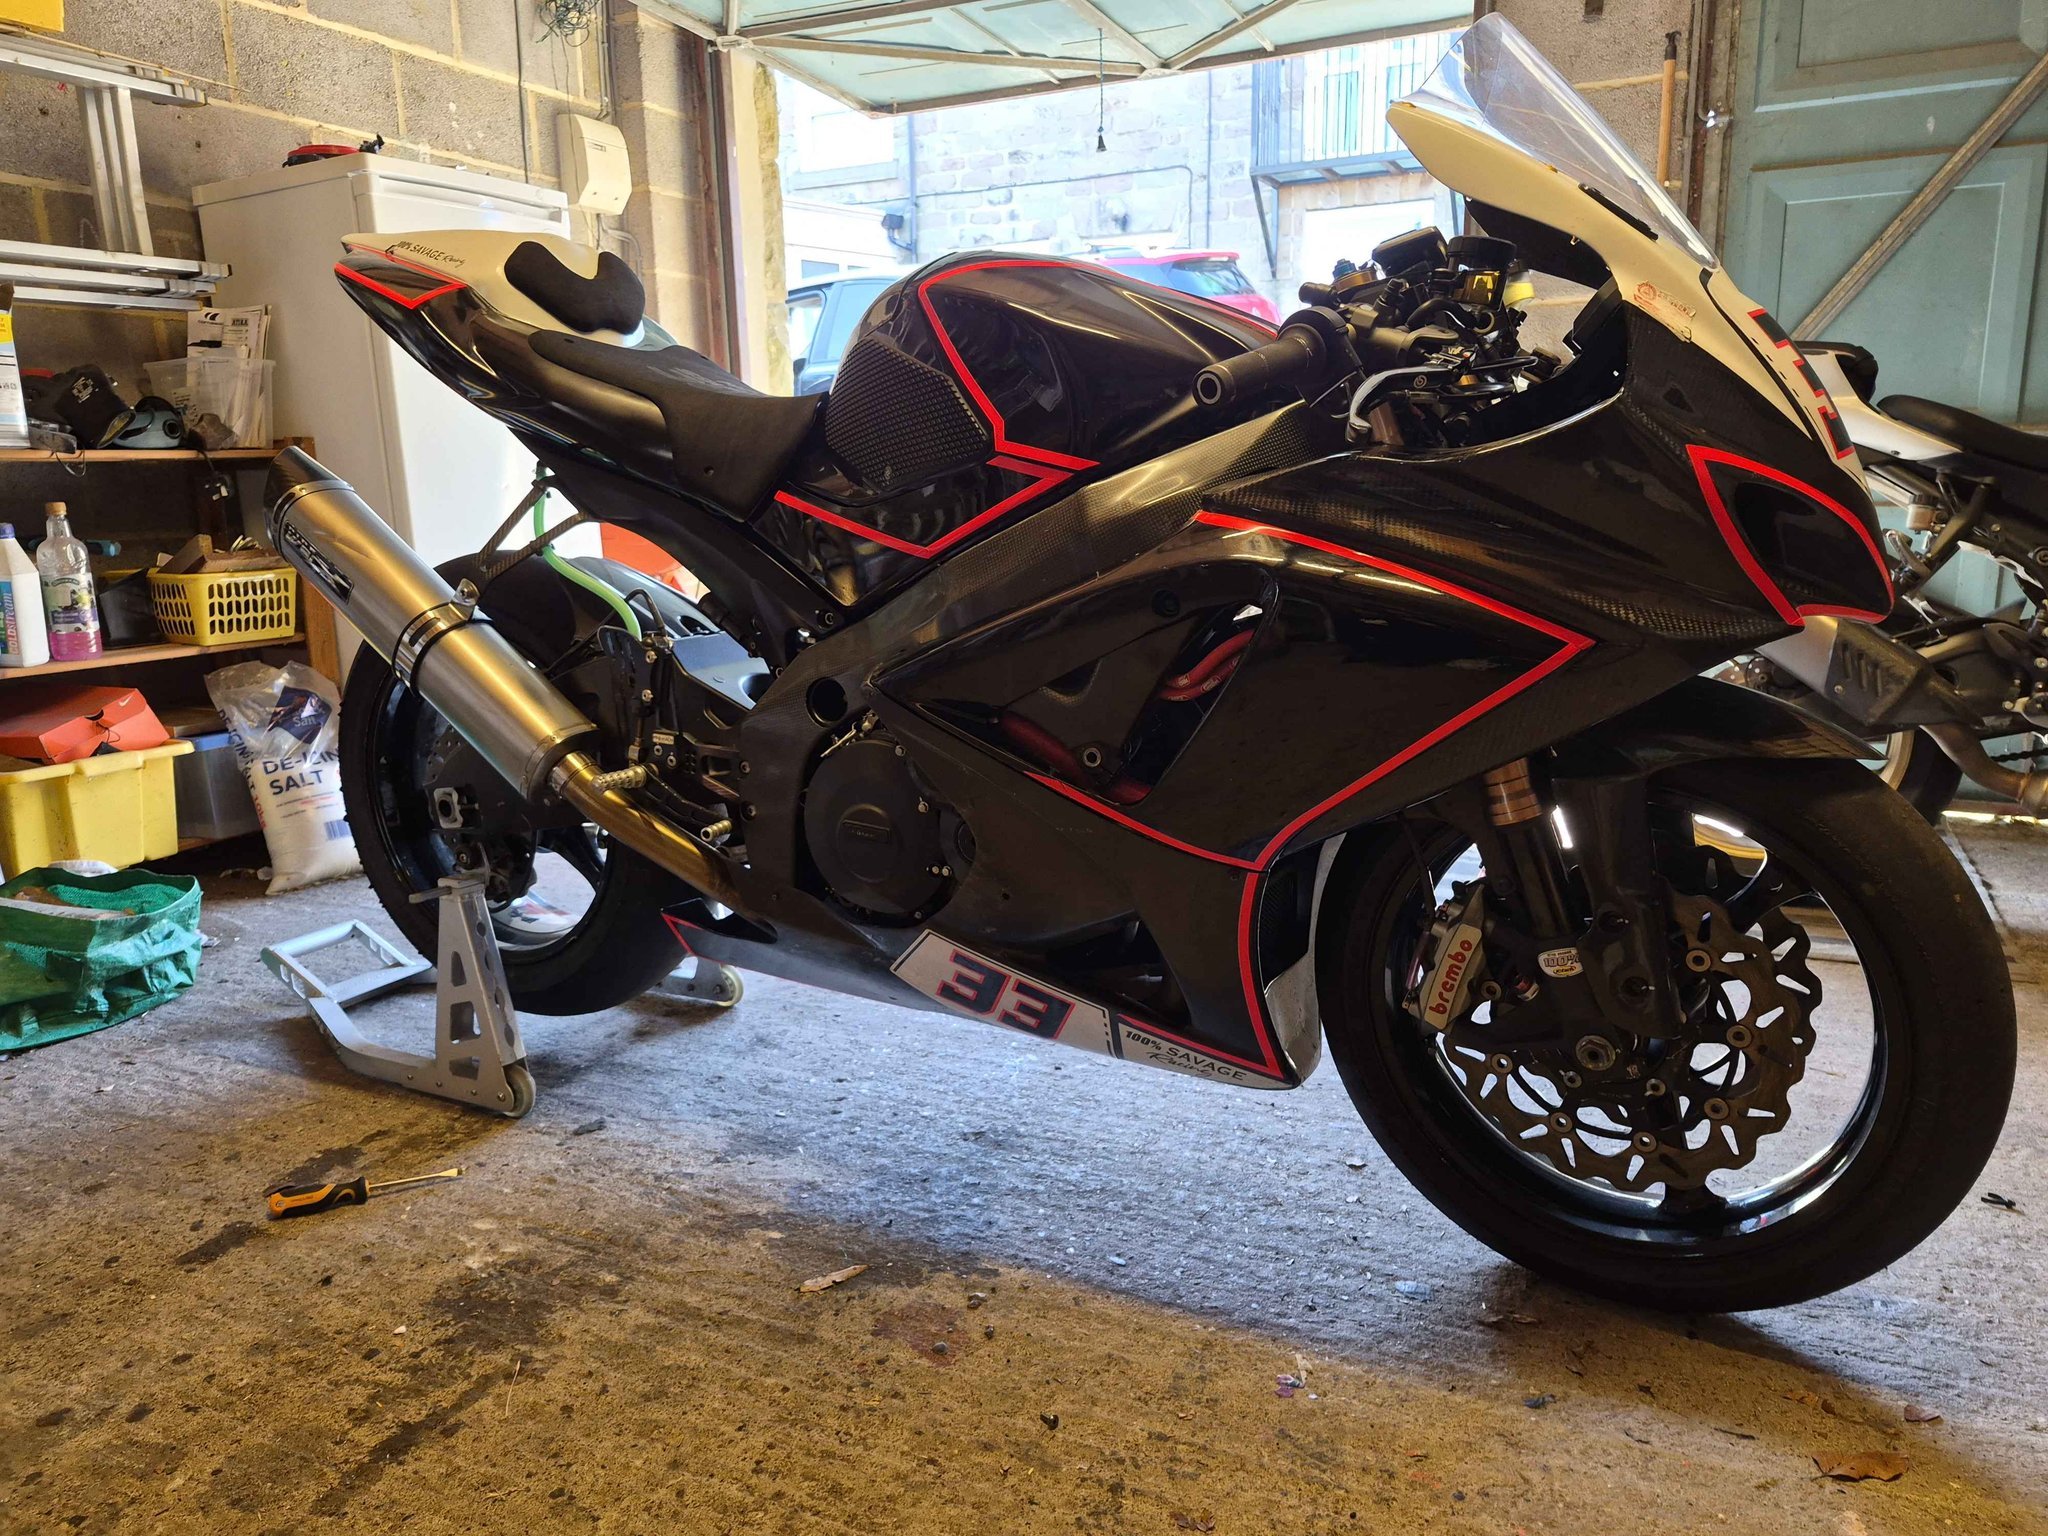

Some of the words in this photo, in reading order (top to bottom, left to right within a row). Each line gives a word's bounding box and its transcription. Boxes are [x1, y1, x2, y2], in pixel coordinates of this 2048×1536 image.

[410, 244, 446, 261] SAVAGE
[263, 749, 339, 775] DE-ICIN
[270, 770, 323, 795] SALT
[1429, 940, 1473, 1015] brembo
[936, 948, 1076, 1040] 33
[1126, 1030, 1162, 1051] 100%
[1166, 1047, 1248, 1081] SAVAGE
[1146, 1051, 1213, 1078] Racing
